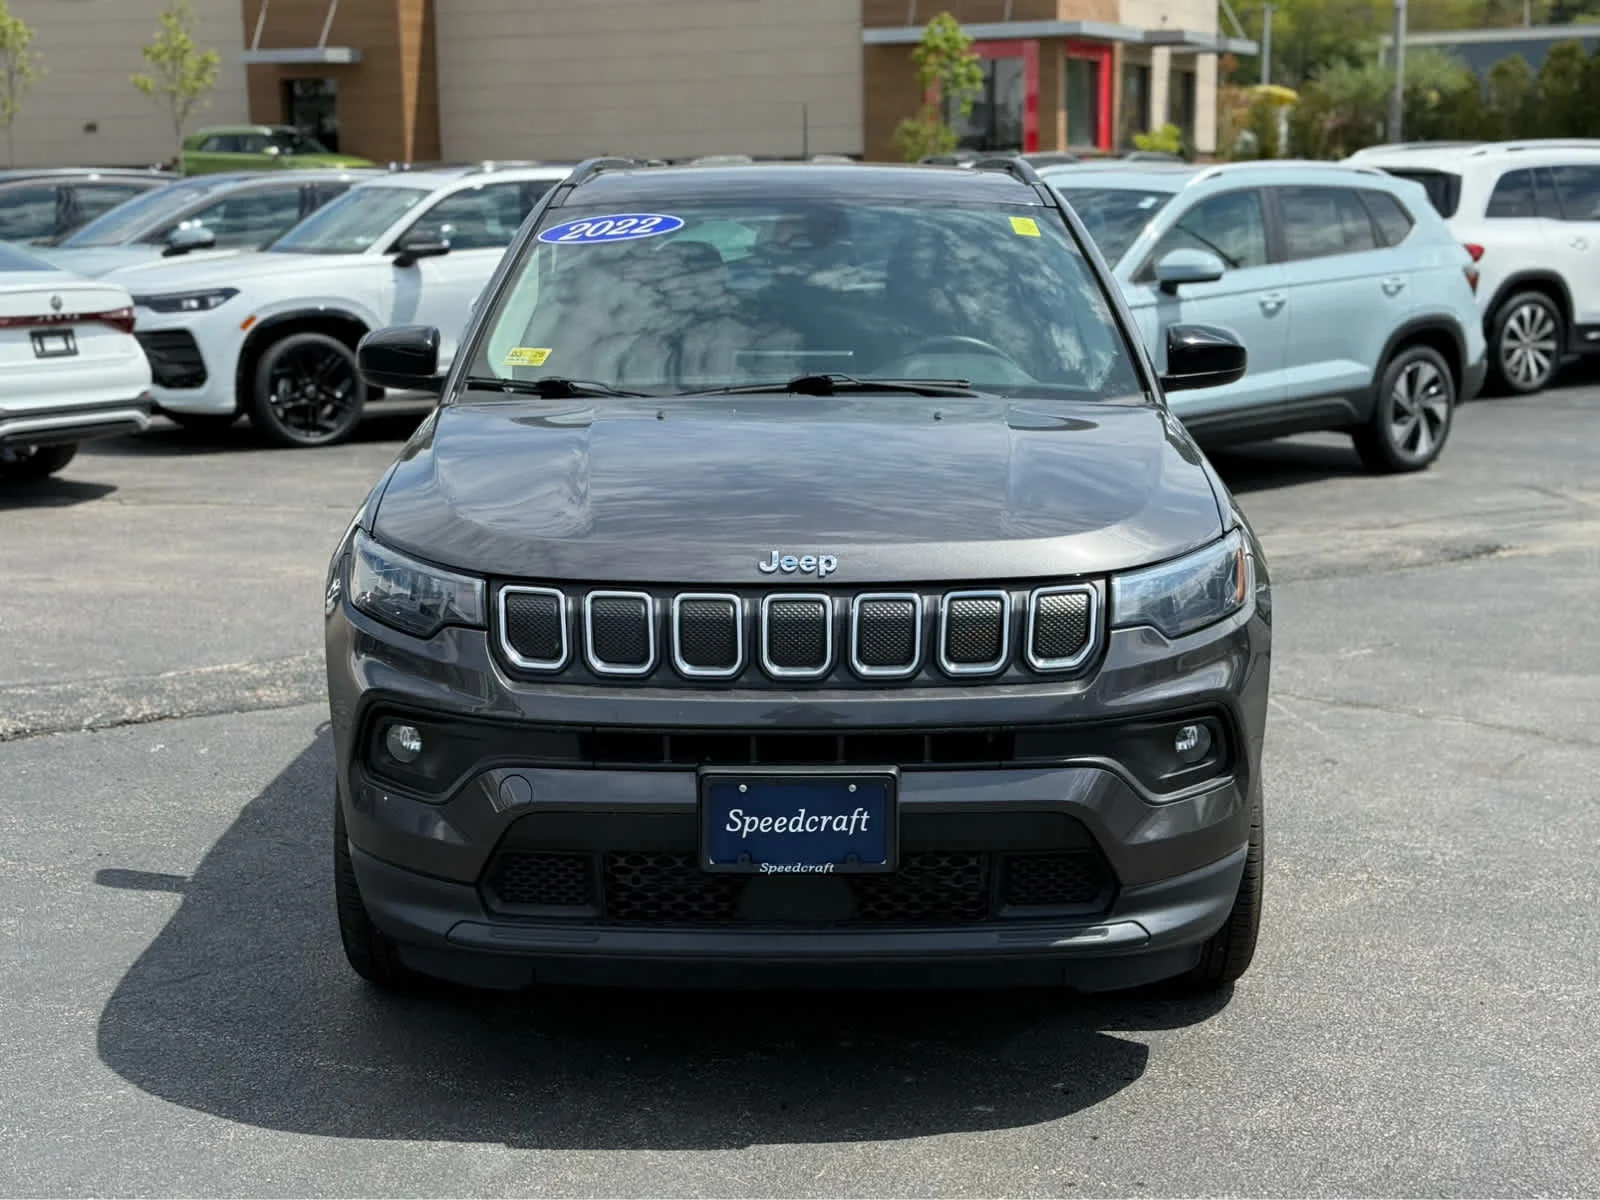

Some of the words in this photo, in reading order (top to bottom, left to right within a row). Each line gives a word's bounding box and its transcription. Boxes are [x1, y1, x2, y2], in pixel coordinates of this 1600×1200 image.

[560, 217, 664, 240] 2022
[758, 551, 838, 577] Jeep
[726, 808, 870, 838] Speedcraft
[759, 862, 835, 875] Speedcraft
